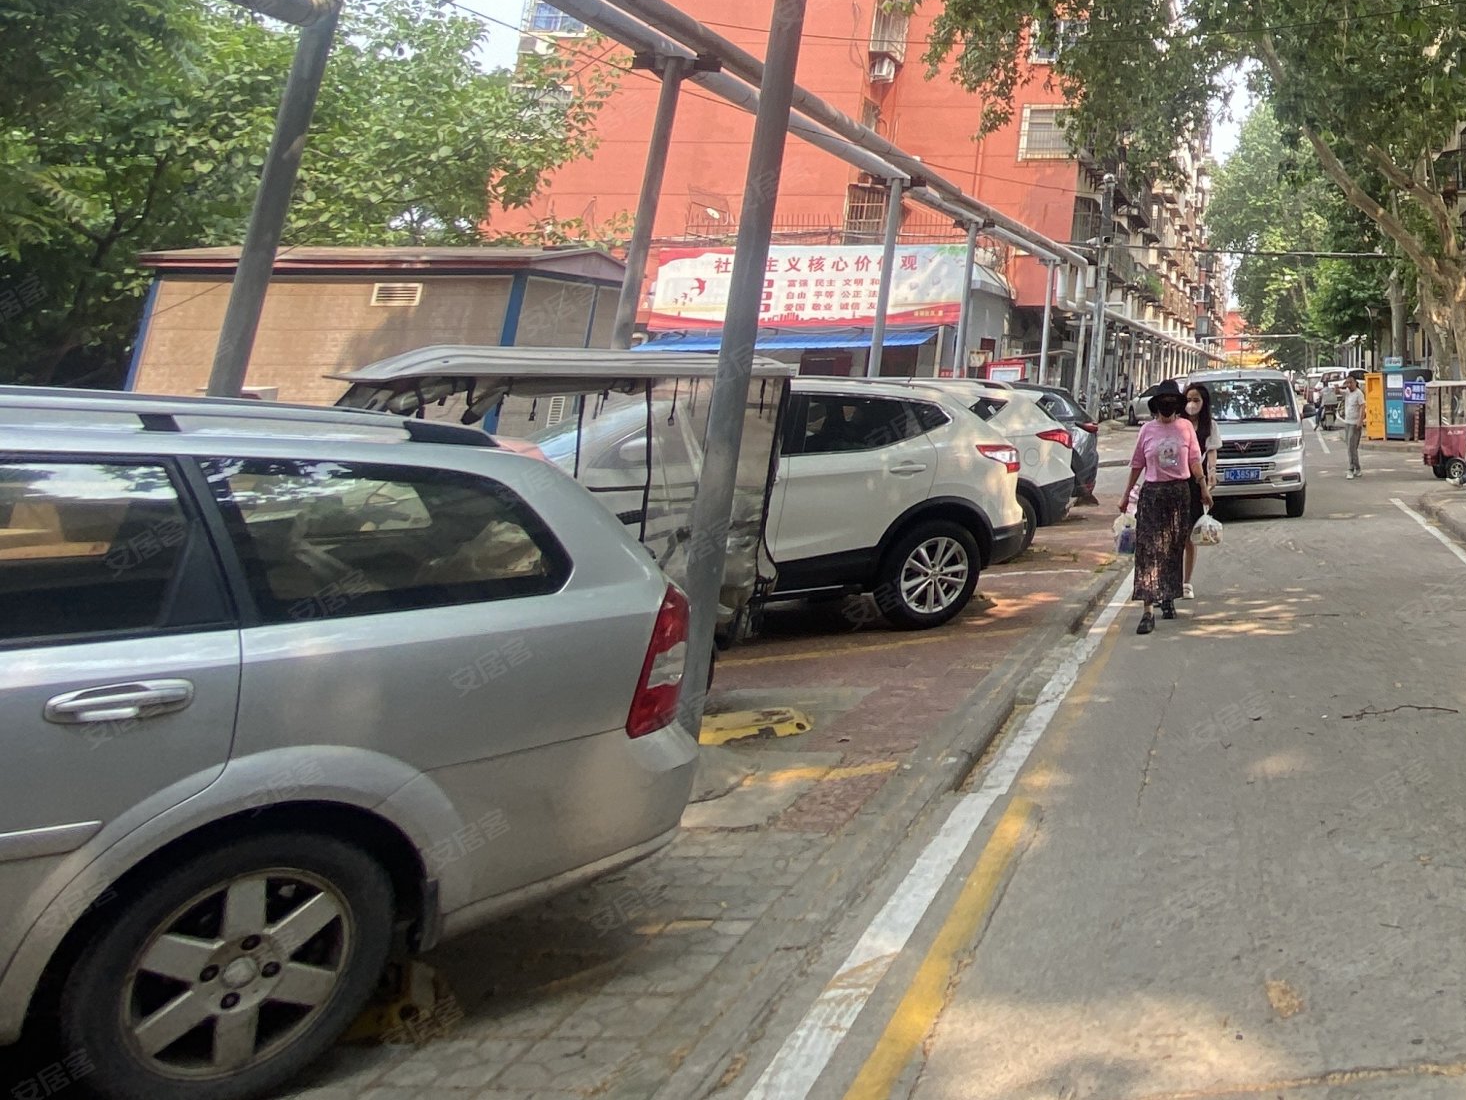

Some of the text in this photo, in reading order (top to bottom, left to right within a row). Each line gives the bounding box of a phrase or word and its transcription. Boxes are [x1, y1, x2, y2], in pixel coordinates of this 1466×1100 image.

[713, 255, 918, 275] 社主义核心价观
[786, 291, 807, 300] 自由
